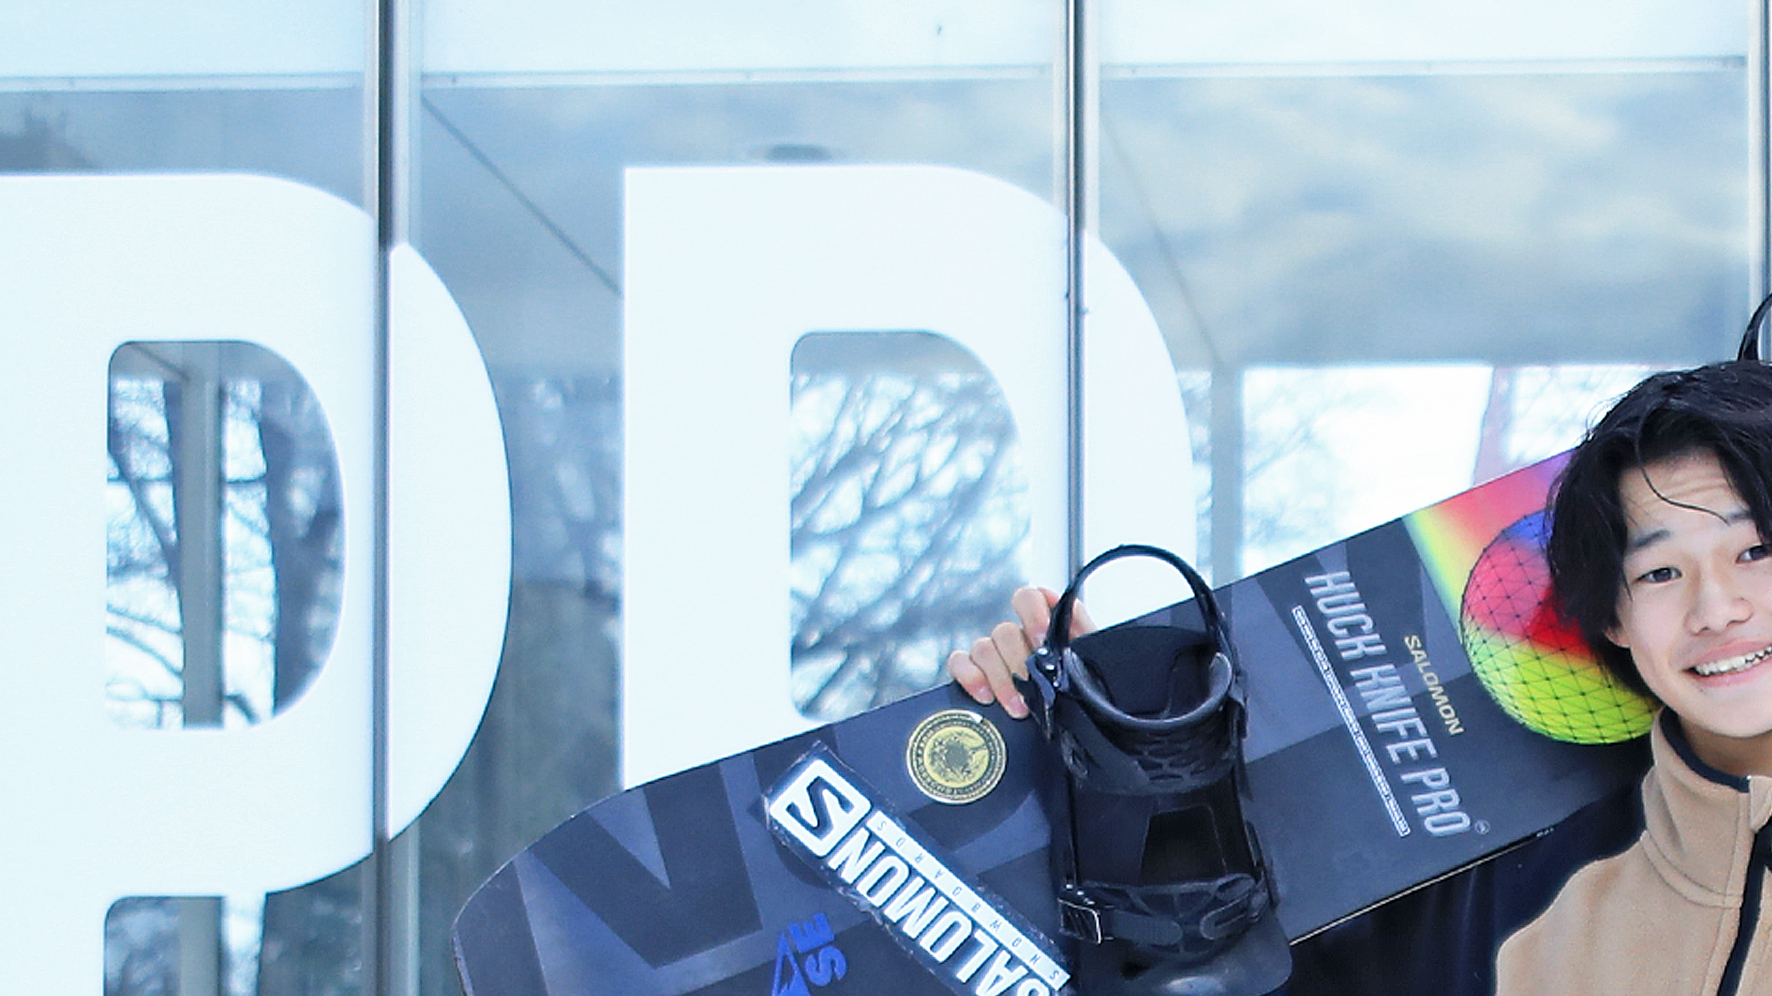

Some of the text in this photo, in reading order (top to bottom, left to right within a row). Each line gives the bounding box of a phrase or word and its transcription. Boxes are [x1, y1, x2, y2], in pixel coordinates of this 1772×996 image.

[1304, 570, 1388, 661] HUCK
[1349, 663, 1437, 766] KNIFE
[1400, 766, 1471, 838] PRO
[1403, 634, 1465, 737] SALOMON
[876, 819, 1060, 983] SNOWBOARDS
